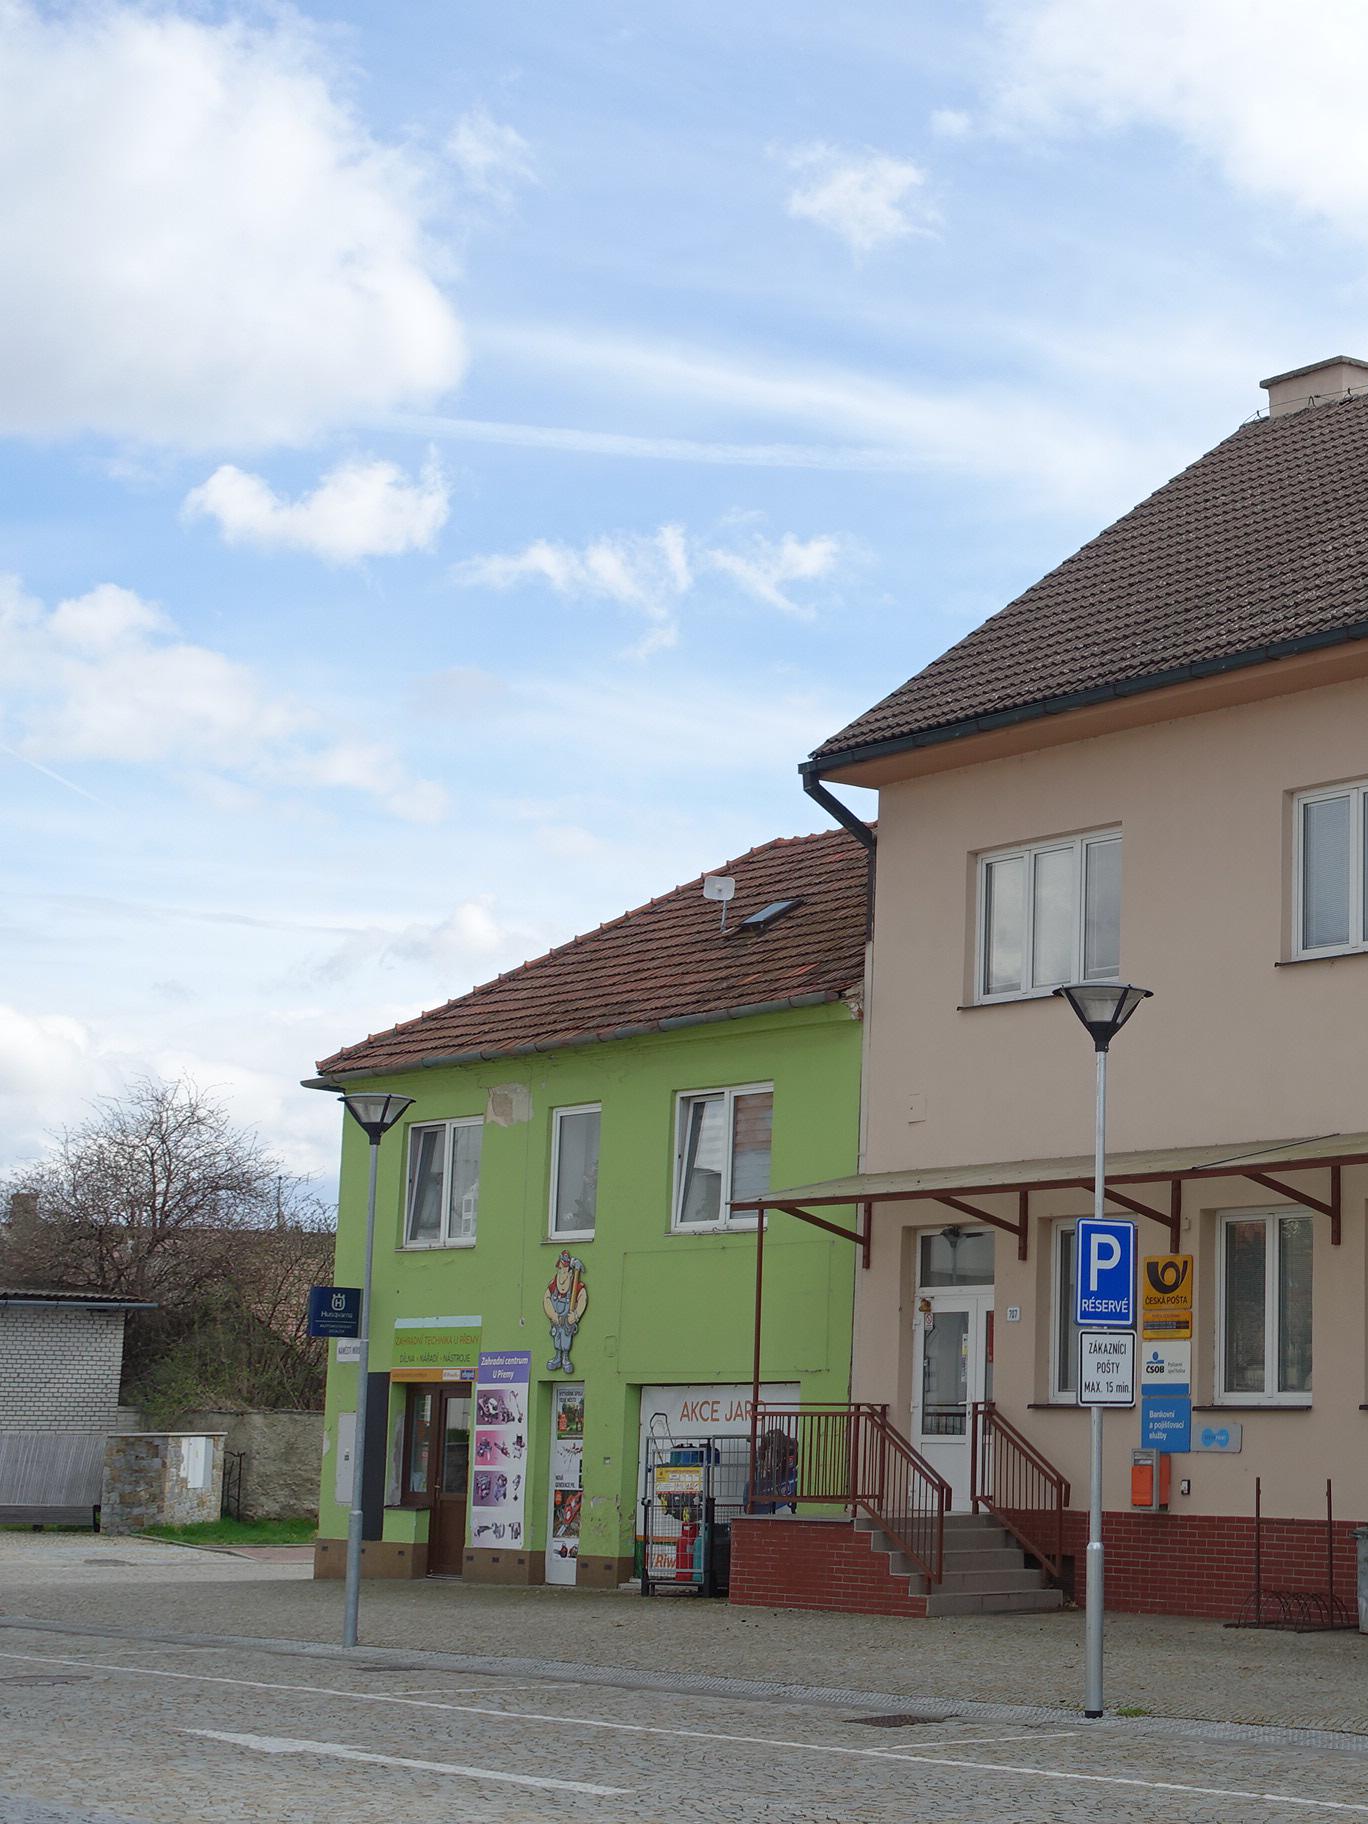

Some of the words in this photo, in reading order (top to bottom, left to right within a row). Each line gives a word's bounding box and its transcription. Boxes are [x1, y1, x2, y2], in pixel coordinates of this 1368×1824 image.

[1089, 1233, 1122, 1292] P
[1081, 1297, 1128, 1313] RÉSERVÉ
[1144, 1295, 1166, 1305] ČESKÁ
[1166, 1295, 1188, 1305] POŠTA
[1088, 1340, 1126, 1355] ZÁKAZNÍCI
[480, 1355, 505, 1366] Zahradní
[504, 1356, 529, 1365] centrum
[1096, 1360, 1120, 1375] POŠTY
[1084, 1380, 1103, 1393] MAX.
[1105, 1381, 1114, 1393] 15
[679, 1400, 720, 1422] AKCE
[1149, 1409, 1175, 1419] Bankovní
